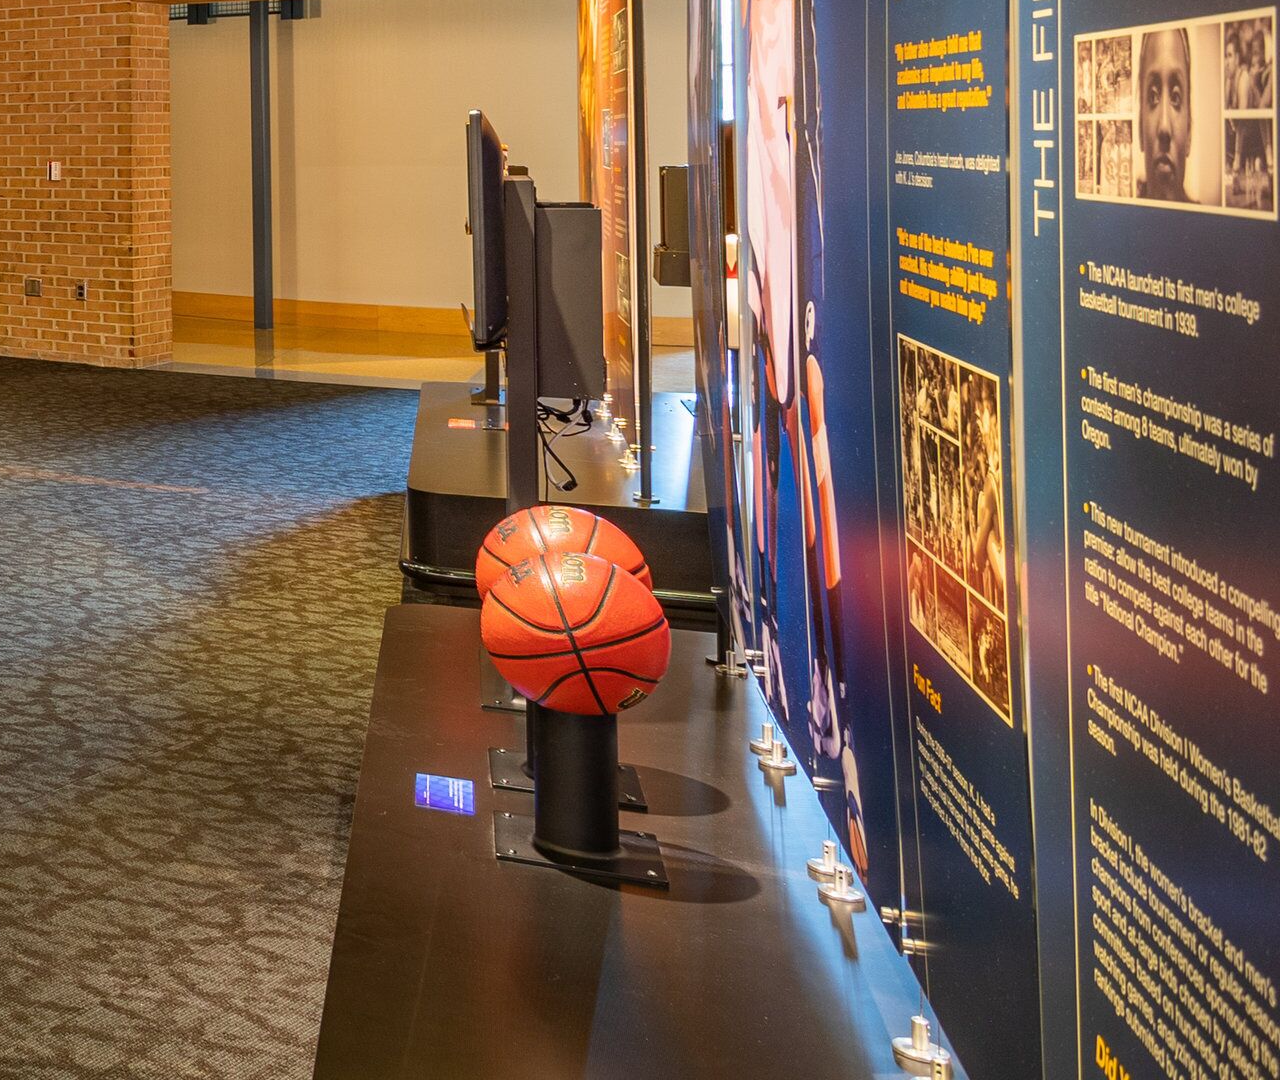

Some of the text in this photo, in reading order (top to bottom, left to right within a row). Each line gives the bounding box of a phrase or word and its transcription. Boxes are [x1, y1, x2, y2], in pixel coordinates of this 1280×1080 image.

[1032, 87, 1056, 237] THE
[1080, 287, 1199, 338] basketball tournament in 1939.
[1087, 261, 1260, 325] The NCAA launched its first men's college
[912, 664, 942, 714] Fun Fact
[1096, 1034, 1118, 1080] Did
